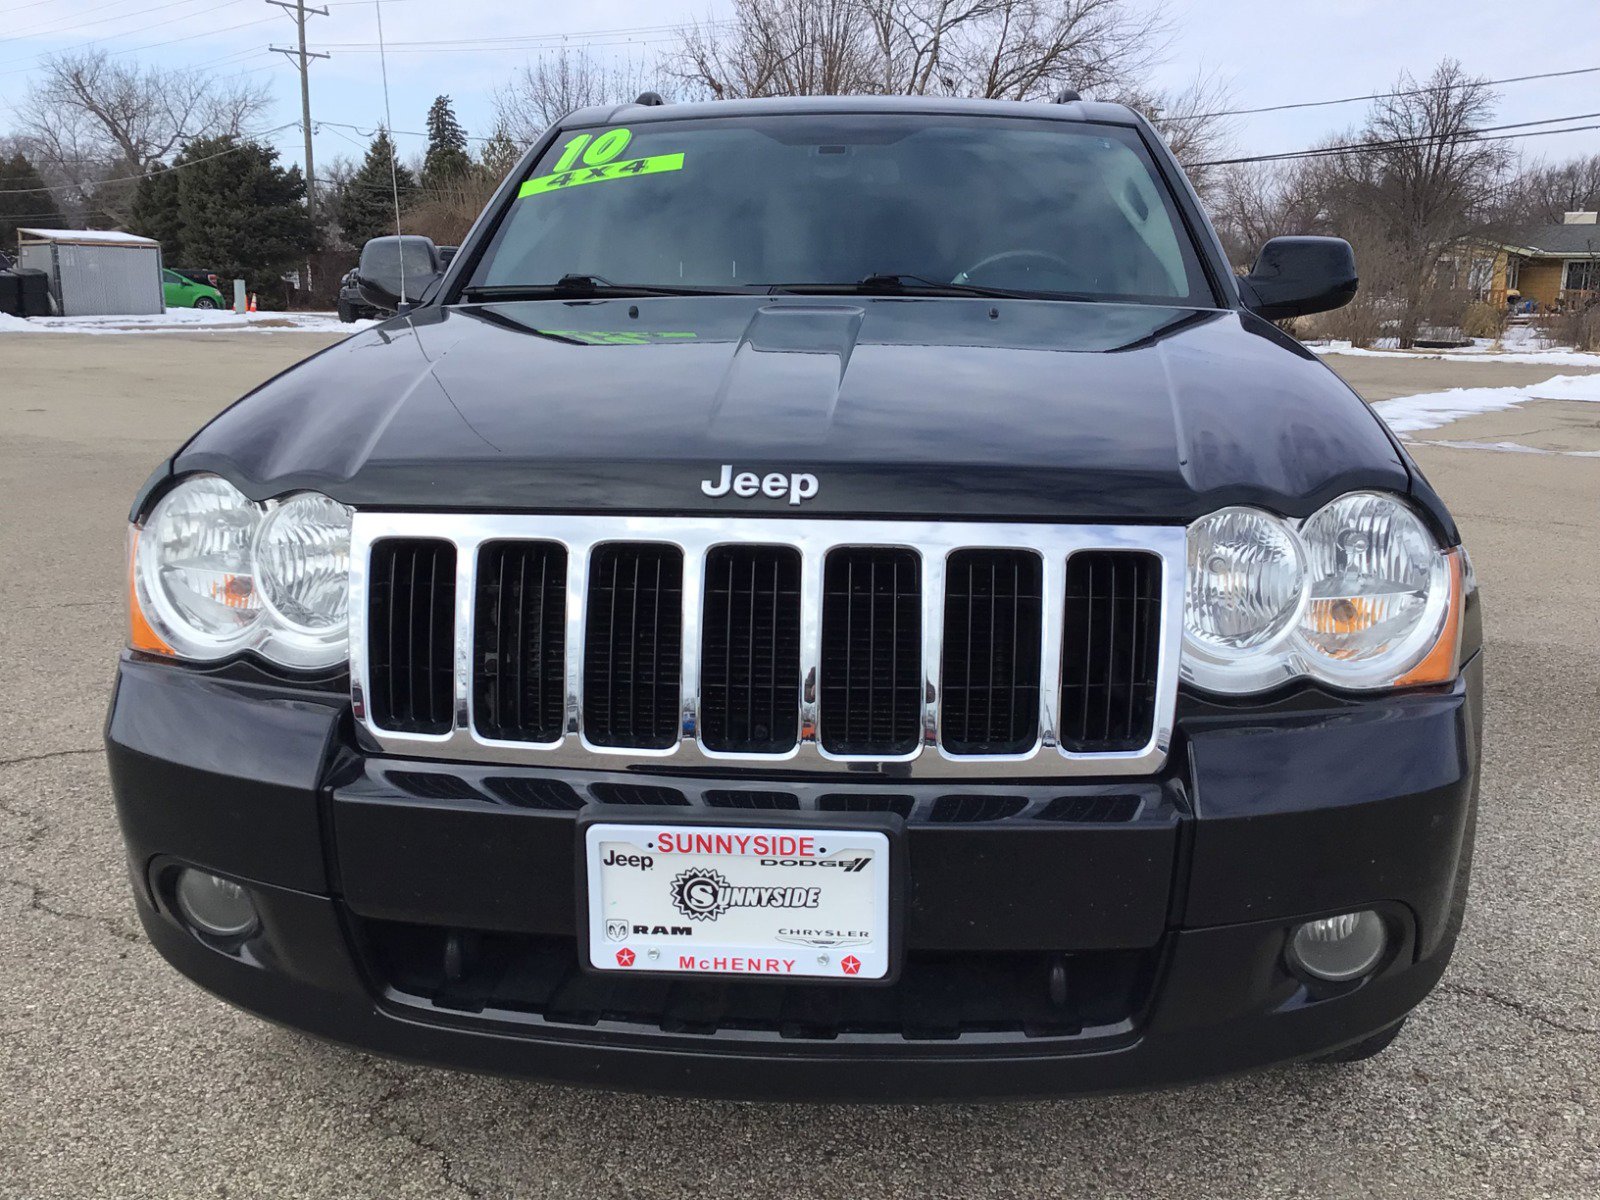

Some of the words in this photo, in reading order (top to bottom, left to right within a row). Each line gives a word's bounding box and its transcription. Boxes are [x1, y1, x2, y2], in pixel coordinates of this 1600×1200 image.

[553, 128, 632, 172] 10
[701, 465, 819, 505] Jeep
[657, 832, 815, 857] SUNNYSIDE
[603, 850, 653, 871] Jeep
[760, 859, 855, 868] DODGE
[687, 879, 821, 908] SUNNYSIDE
[633, 925, 692, 936] RAM
[778, 928, 869, 938] CHRYSLER
[679, 956, 796, 973] McHENRY
